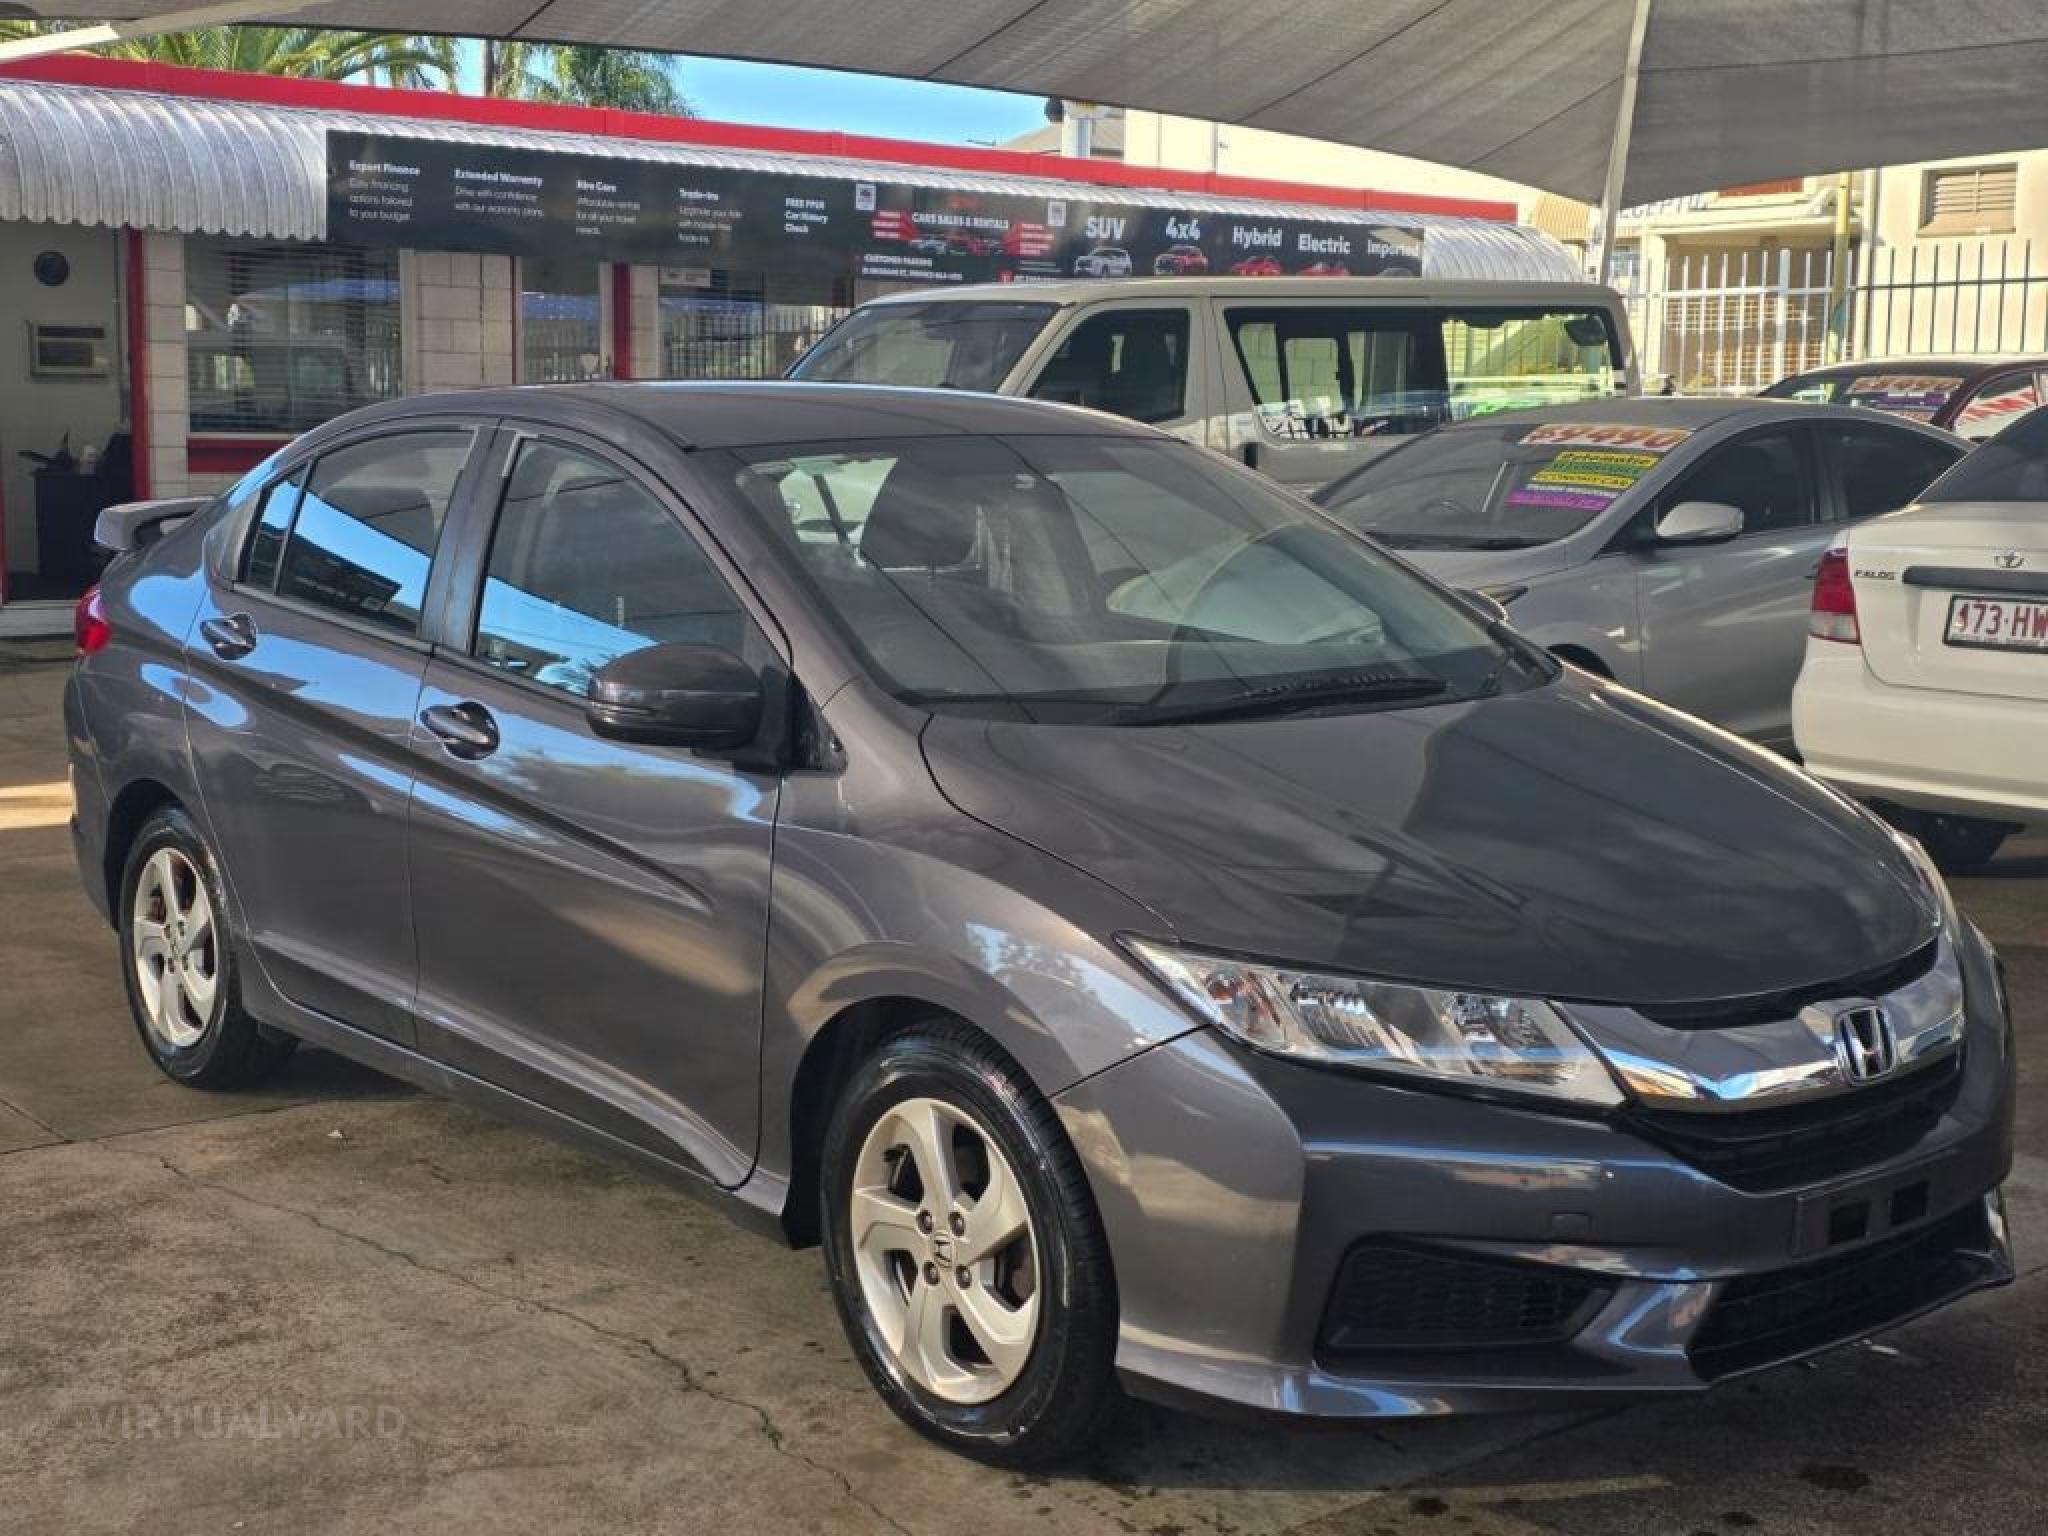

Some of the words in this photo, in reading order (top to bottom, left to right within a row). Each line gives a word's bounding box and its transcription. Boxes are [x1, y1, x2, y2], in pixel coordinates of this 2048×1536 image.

[455, 168, 499, 181] Extended
[500, 172, 543, 188] Warranty
[1086, 215, 1127, 240] SUV
[1166, 216, 1201, 240] 4x4
[1232, 225, 1283, 249] Hybrid
[1298, 233, 1351, 255] Electric
